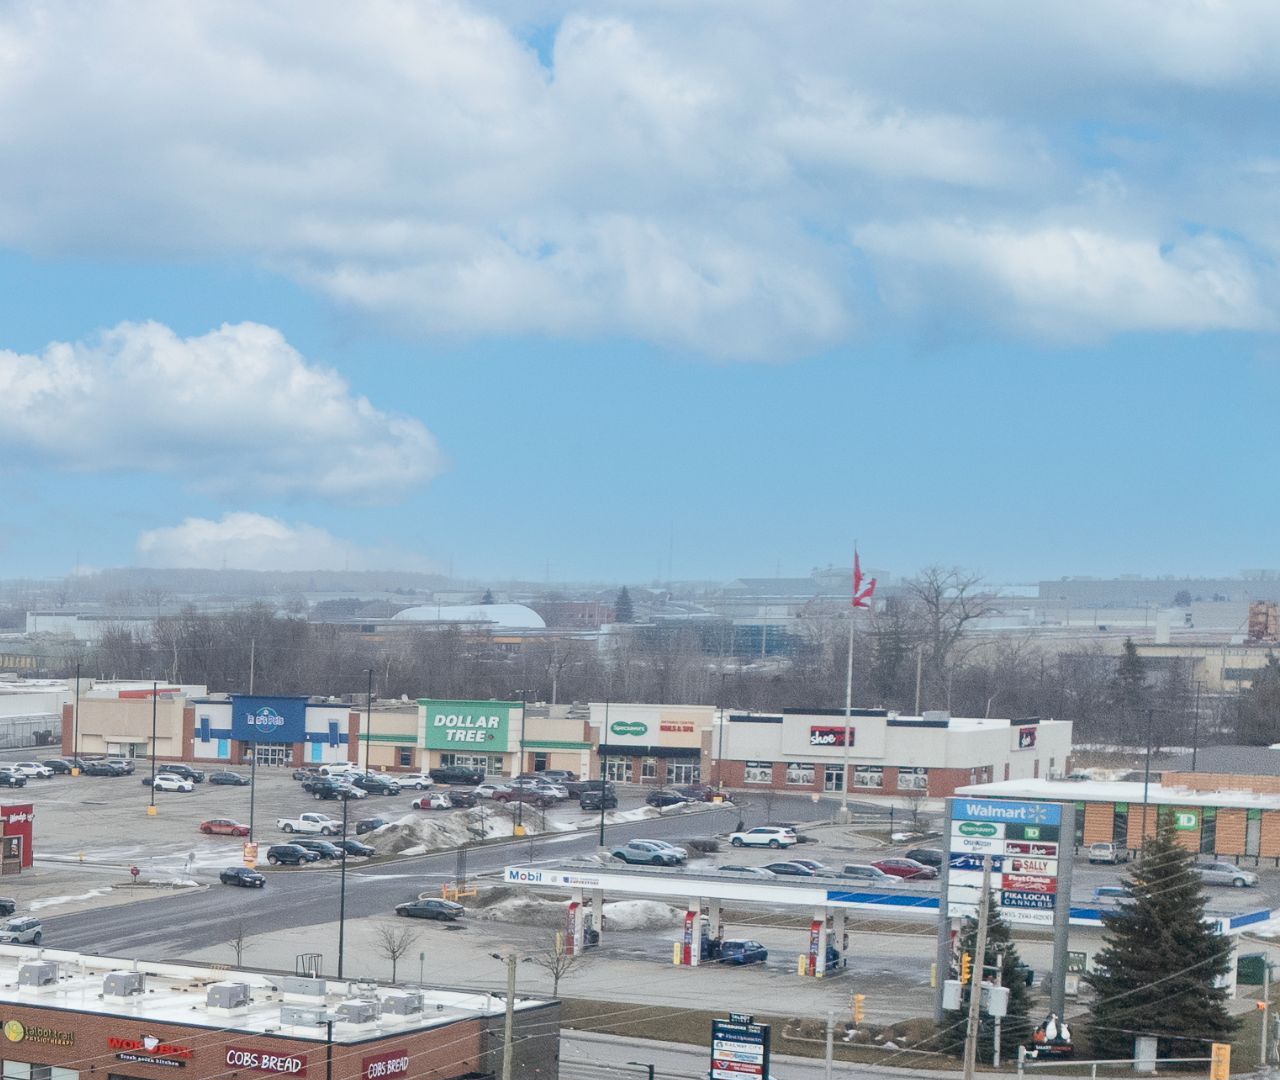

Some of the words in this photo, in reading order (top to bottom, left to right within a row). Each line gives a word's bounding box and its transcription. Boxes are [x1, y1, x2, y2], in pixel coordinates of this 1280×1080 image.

[434, 714, 500, 728] DOLLAR
[446, 729, 487, 742] TREE
[810, 730, 837, 745] shoe
[966, 803, 1027, 819] Walmart
[1026, 828, 1040, 838] TD
[1023, 860, 1048, 872] SALLY
[509, 870, 542, 881] Mobil
[1004, 900, 1053, 908] CANNABIS
[1024, 893, 1052, 902] LOCAL
[108, 1037, 143, 1050] WOK
[226, 1050, 259, 1067] COBS
[261, 1054, 302, 1073] BREAD
[367, 1061, 387, 1079] COBS
[386, 1056, 410, 1074] BREAD
